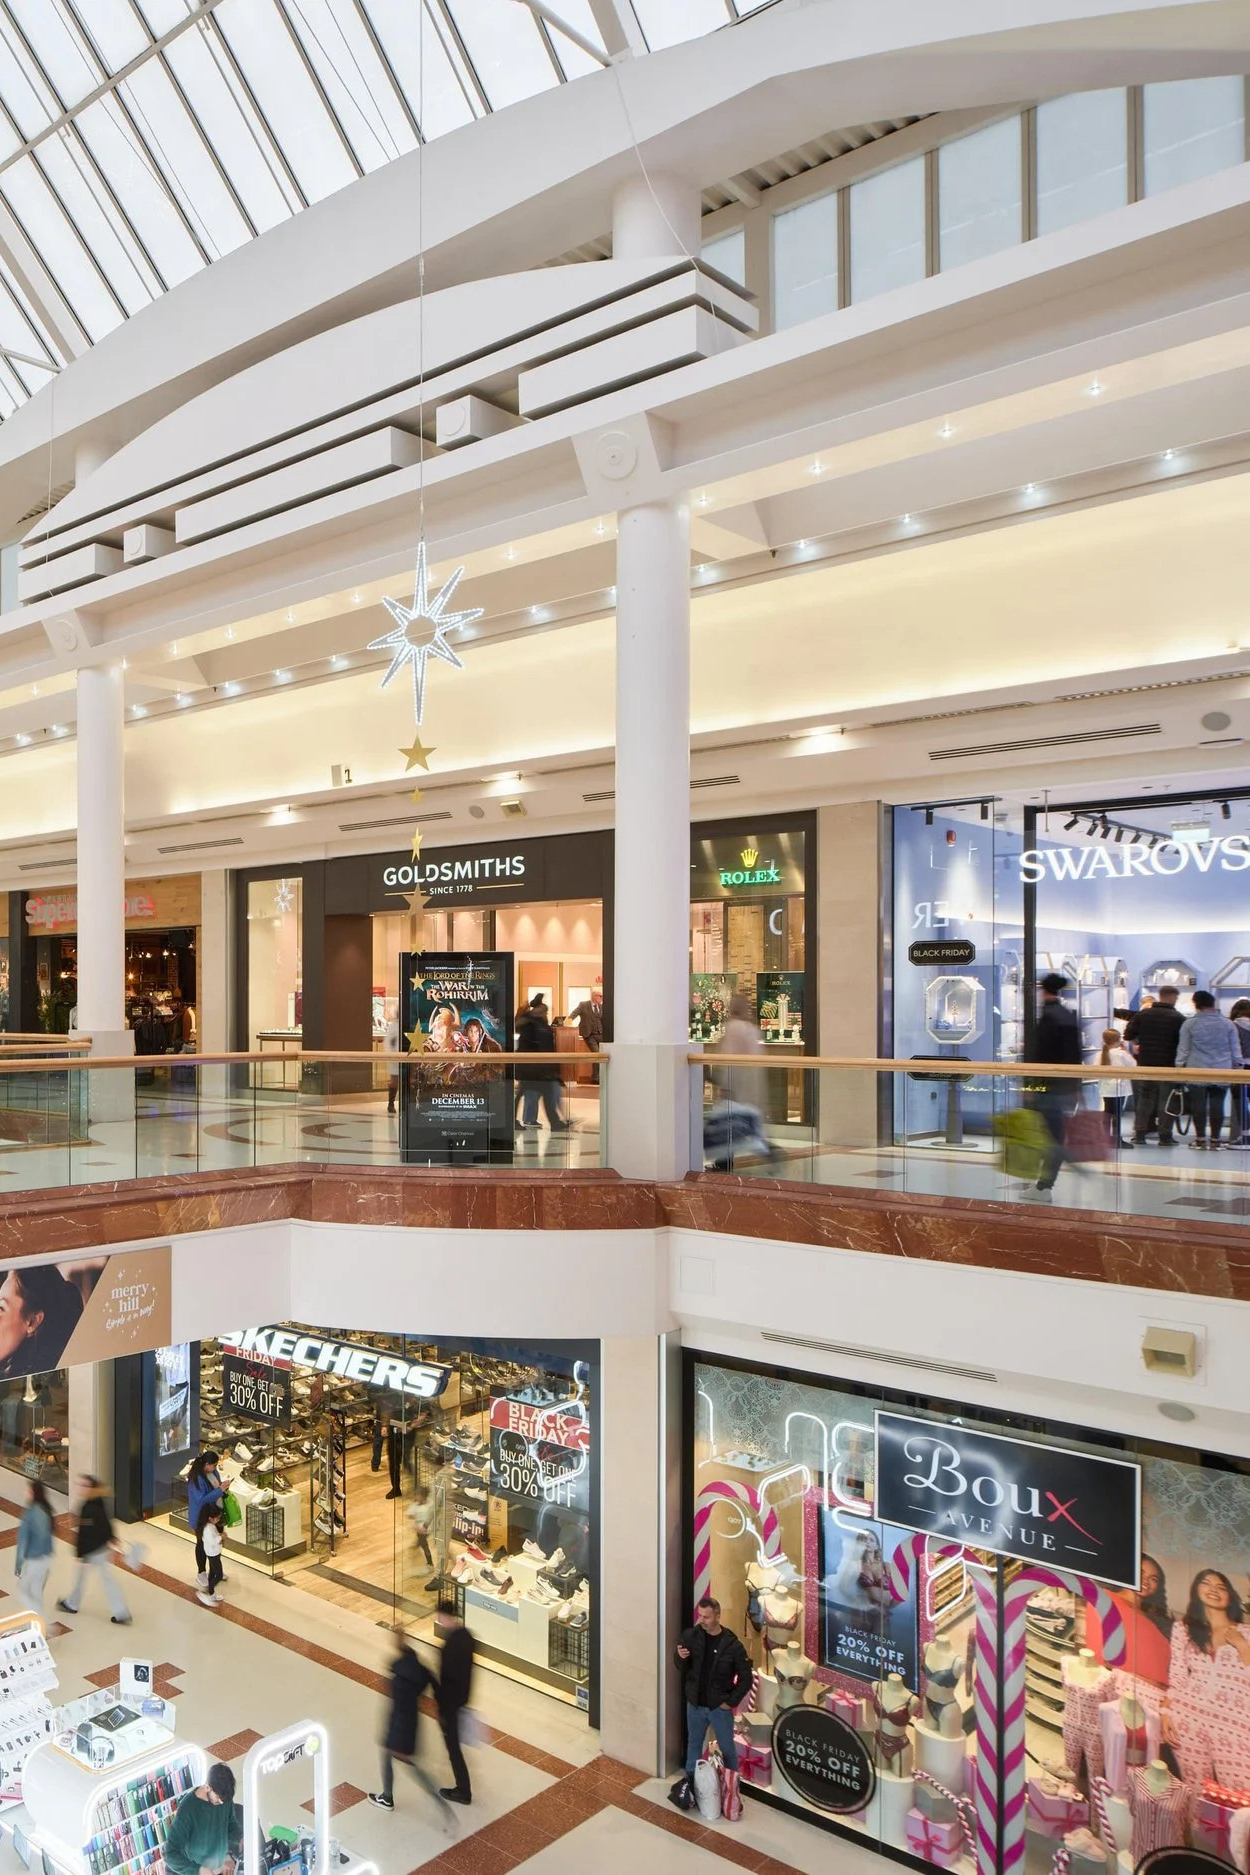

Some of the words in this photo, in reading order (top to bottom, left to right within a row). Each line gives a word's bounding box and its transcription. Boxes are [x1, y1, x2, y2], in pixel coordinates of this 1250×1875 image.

[383, 855, 526, 886] GOLDSMITHS
[719, 869, 781, 886] ROLEX
[429, 886, 454, 895] SINCE
[456, 884, 473, 893] 1778
[913, 949, 940, 957] BLACK
[941, 948, 970, 957] FRIDAY
[426, 988, 489, 1003] ROHIRRIM
[438, 981, 470, 991] WAR
[432, 1097, 475, 1105] DECEMBER
[477, 1097, 485, 1105] 13
[111, 1283, 149, 1299] merry
[119, 1296, 139, 1313] hill
[217, 1325, 445, 1398] SKECHERS
[236, 1347, 276, 1366] FRIDAY
[229, 1370, 241, 1384] BUY
[257, 1379, 269, 1392] GET
[230, 1383, 257, 1410] 30%
[260, 1391, 283, 1417] OFF
[509, 1401, 568, 1432] BLACK
[509, 1418, 569, 1446] FRIDAY
[499, 1448, 517, 1464] BUY
[540, 1460, 557, 1476] GET
[500, 1463, 539, 1498] 30%
[543, 1475, 577, 1508] OFF
[903, 1436, 1103, 1546] Boux
[944, 1510, 1057, 1552] AVENUE
[837, 1633, 870, 1653] 20%
[875, 1646, 904, 1664] OFF
[845, 1625, 868, 1639] BLACK
[870, 1633, 897, 1647] FRIDAY
[836, 1646, 906, 1676] EVERYTHING
[786, 1729, 818, 1748] BLACK
[822, 1743, 860, 1764] FRIDAY
[786, 1740, 821, 1763] 20%
[827, 1757, 860, 1778] OFF
[786, 1754, 861, 1791] EVERYTHING
